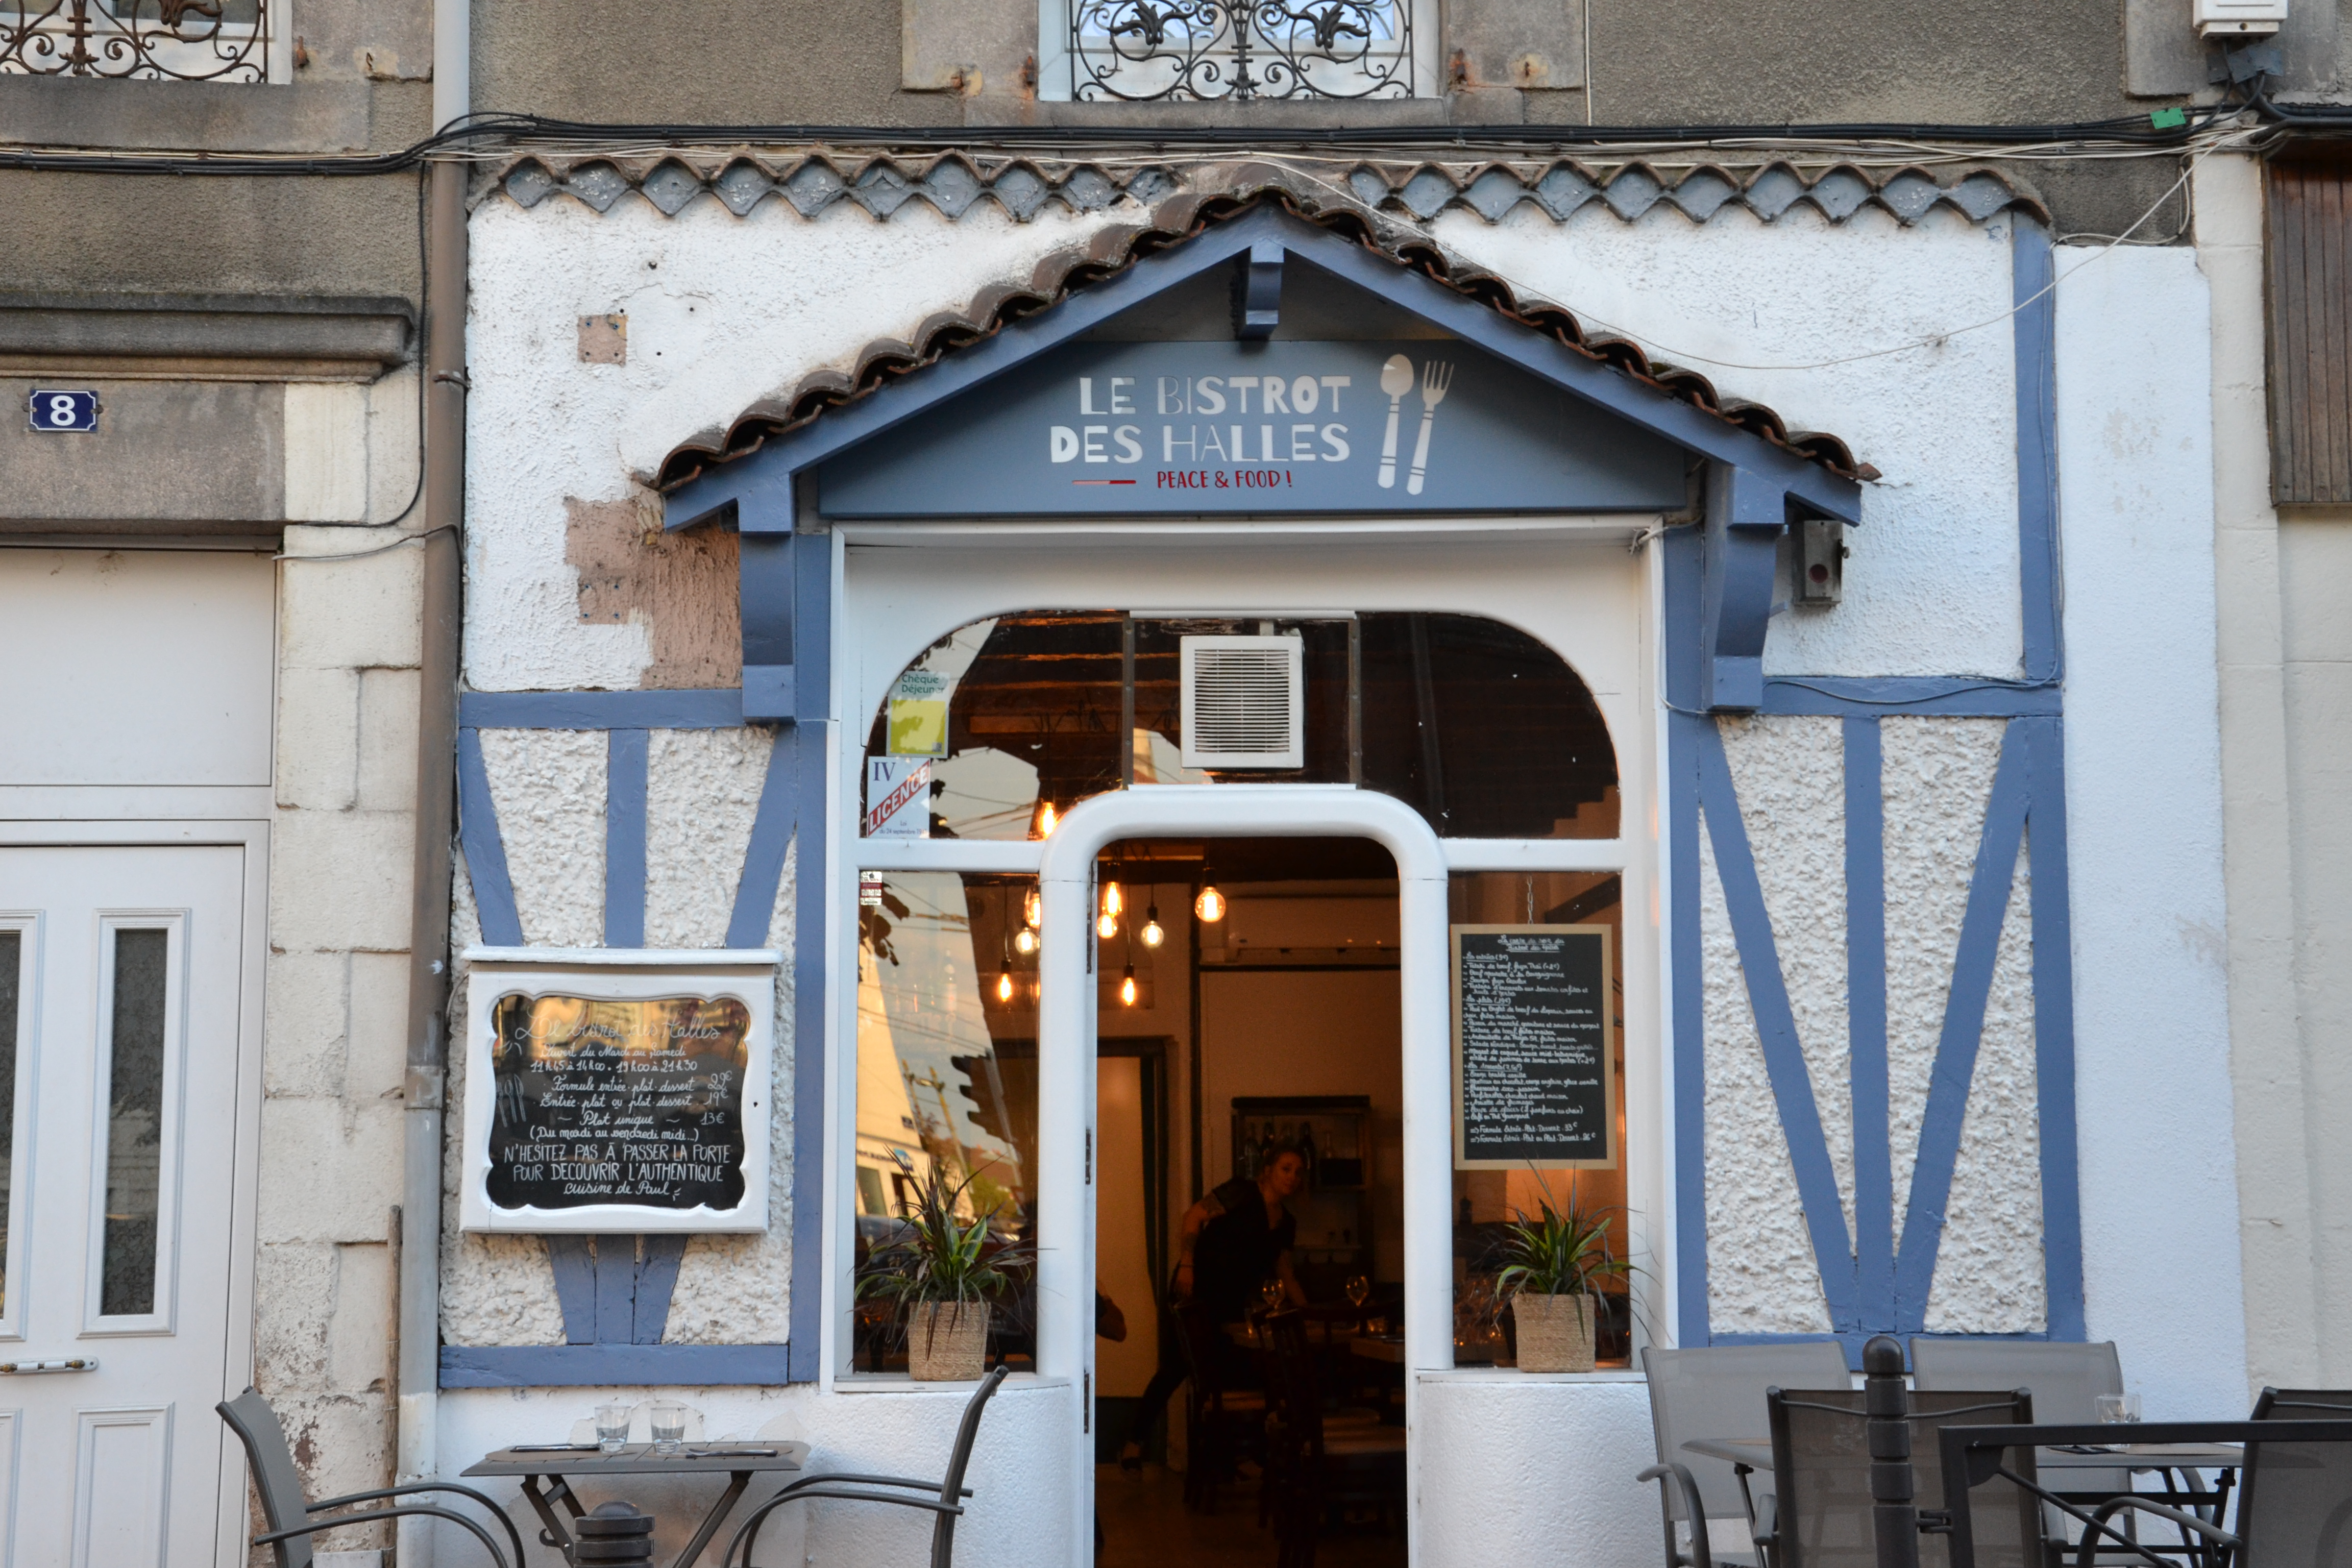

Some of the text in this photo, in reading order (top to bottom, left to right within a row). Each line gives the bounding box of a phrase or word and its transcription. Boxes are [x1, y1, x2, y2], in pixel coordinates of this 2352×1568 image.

[1080, 375, 1351, 415] LE BISTROT
[50, 395, 76, 426] 8
[1050, 423, 1351, 463] DES HALLES
[1157, 471, 1208, 488] PEACE
[1214, 471, 1230, 488] &
[1235, 470, 1280, 488] FOOD
[902, 674, 939, 685] Chèque
[902, 684, 945, 695] Déjeuner
[873, 762, 896, 781] IV
[869, 765, 928, 832] LICENCE
[514, 1006, 561, 1040] Le
[628, 1013, 658, 1037] des
[662, 1007, 721, 1039] Halles
[579, 1044, 596, 1058] du
[598, 1044, 631, 1058] Mardi
[650, 1042, 687, 1059] Samedi
[530, 1059, 698, 1073] 11h45 à 14h00 19h00 à 21h30
[551, 1074, 595, 1091] Formule
[597, 1076, 627, 1092] entrée
[631, 1077, 654, 1099] plat
[658, 1076, 696, 1092] dessert
[540, 1091, 577, 1107] Entrée
[581, 1093, 606, 1114] plat
[611, 1098, 623, 1109] ou
[628, 1094, 651, 1114] plat
[656, 1094, 693, 1107] dessert
[579, 1110, 725, 1130] Plat unique 13€
[559, 1128, 592, 1140] mardi
[595, 1129, 608, 1138] au
[610, 1127, 659, 1141] vendredi
[574, 1144, 599, 1162] PAS
[623, 1143, 669, 1162] PASSER
[673, 1144, 688, 1162] LA
[693, 1143, 731, 1164] PORTE
[513, 1161, 724, 1183] POUR DECOUVRIR L'AUTHENTIQUE
[563, 1180, 671, 1195] cuisine de Paul
